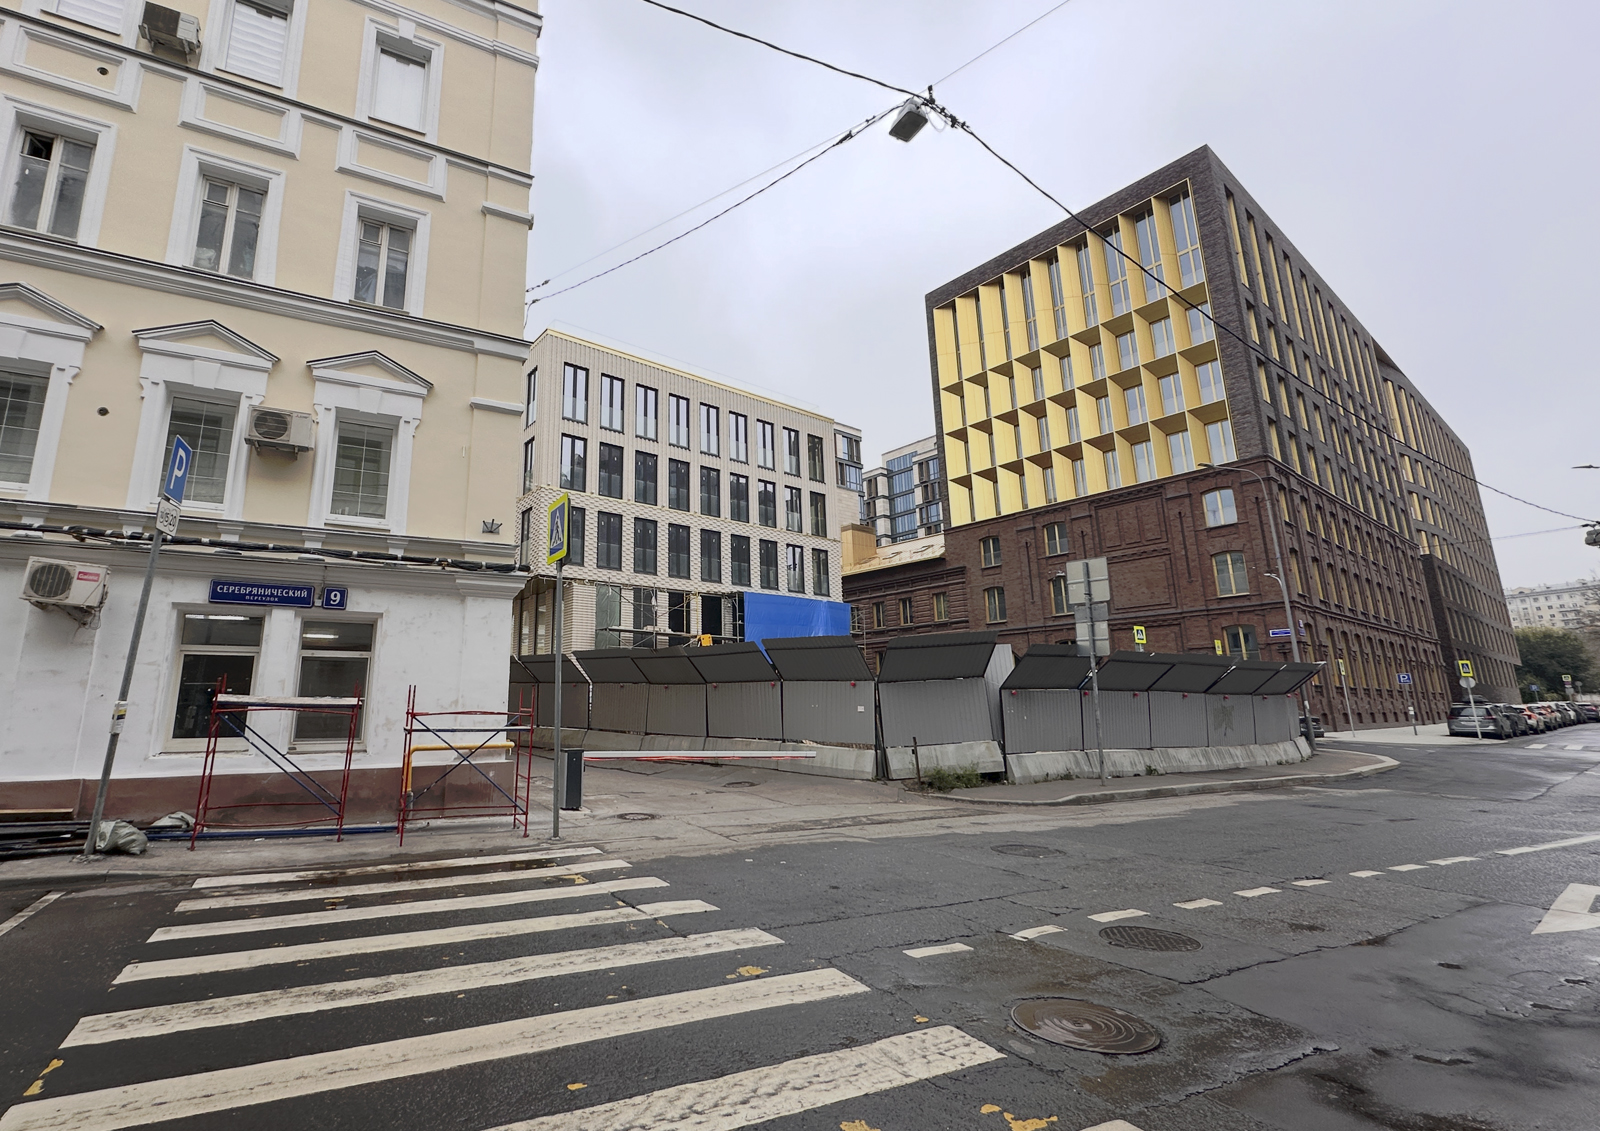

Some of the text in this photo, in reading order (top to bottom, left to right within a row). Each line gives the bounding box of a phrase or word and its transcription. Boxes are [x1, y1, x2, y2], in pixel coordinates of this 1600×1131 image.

[170, 447, 186, 489] P
[217, 585, 308, 597] СЕРЕБРЯНИЧЕСКИЙ
[330, 591, 340, 605] 9
